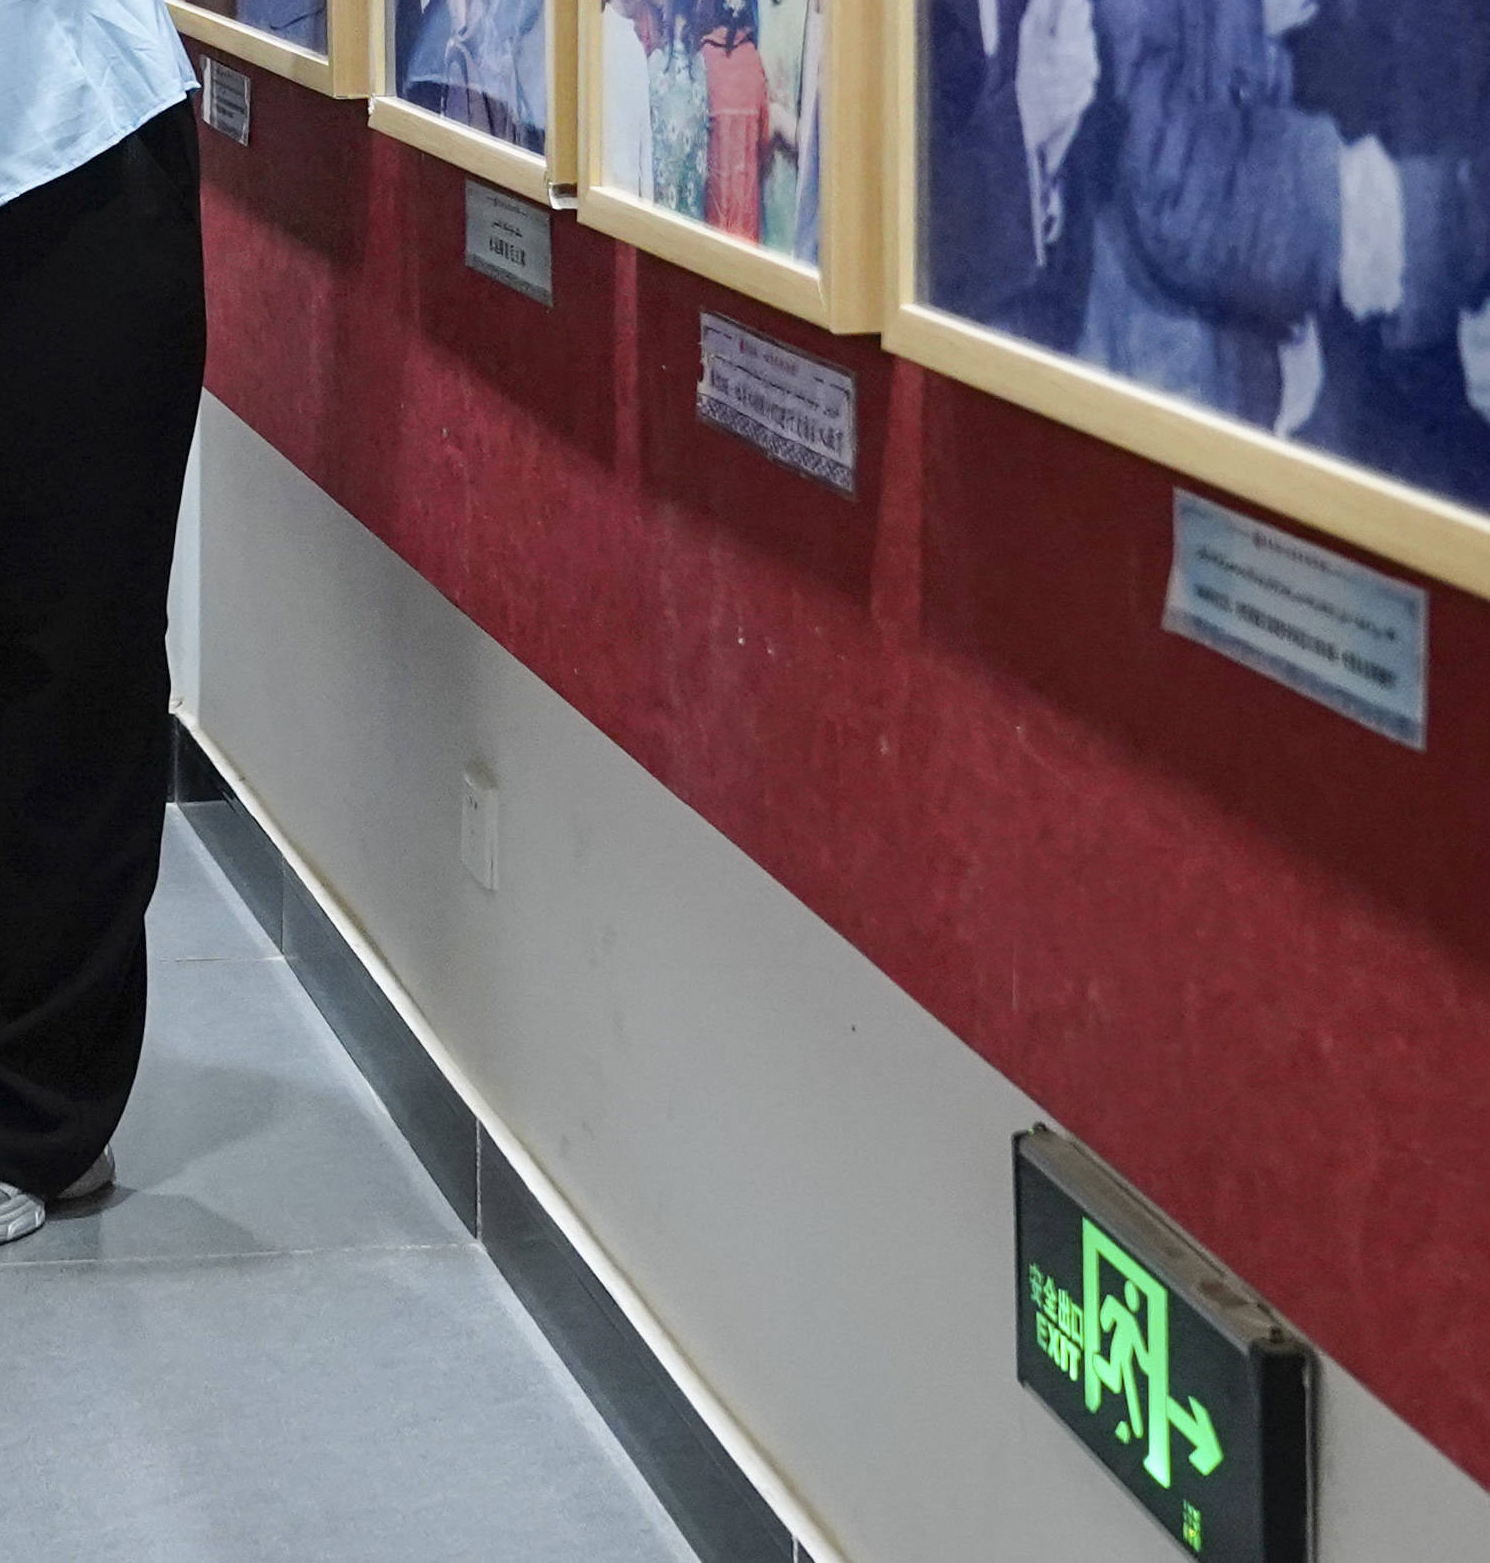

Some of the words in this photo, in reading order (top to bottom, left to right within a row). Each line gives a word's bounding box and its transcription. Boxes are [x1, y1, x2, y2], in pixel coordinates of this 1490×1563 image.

[1029, 1263, 1083, 1349] 安全出口
[1036, 1311, 1081, 1382] EXIT
